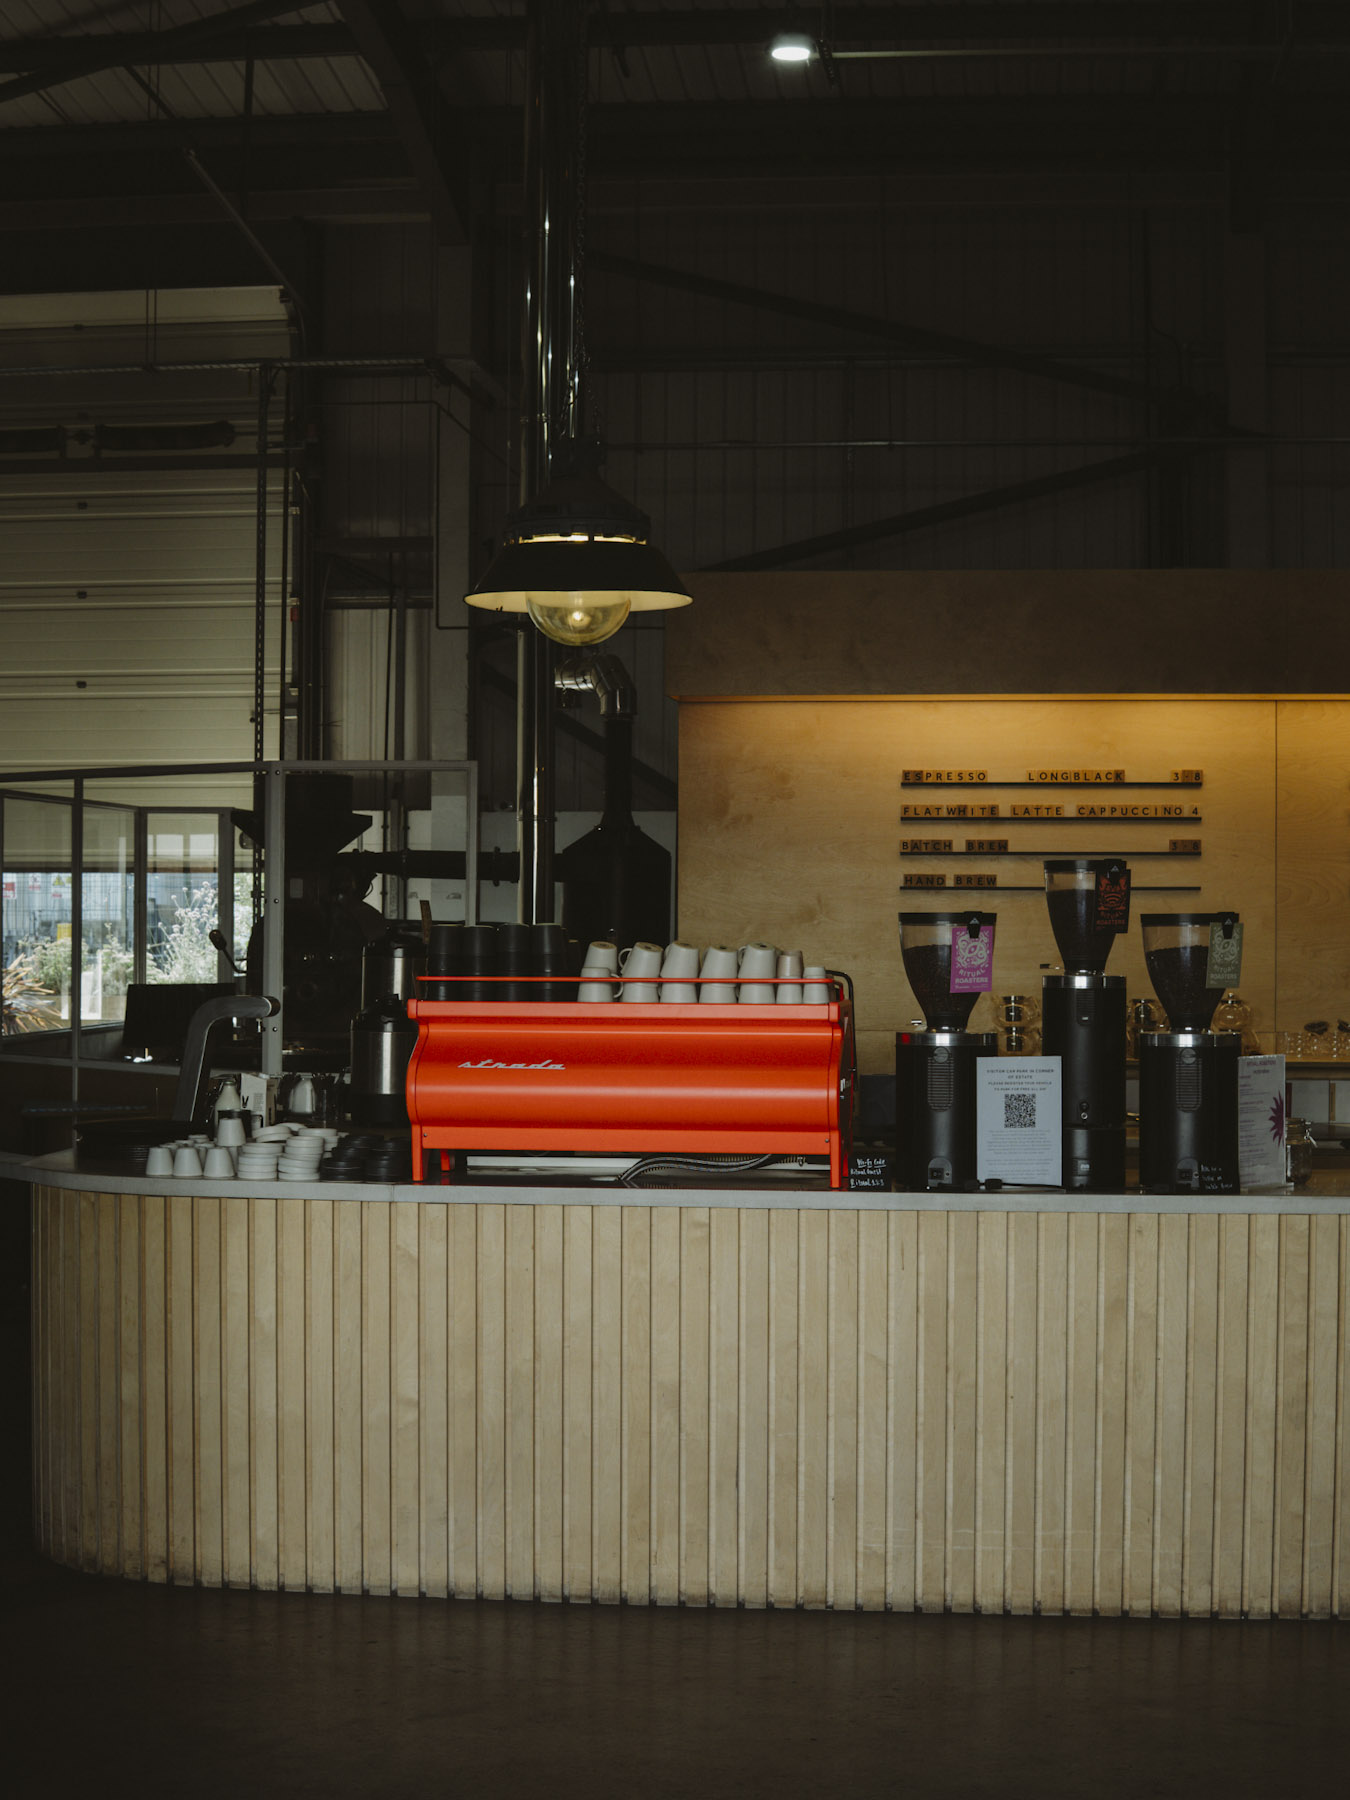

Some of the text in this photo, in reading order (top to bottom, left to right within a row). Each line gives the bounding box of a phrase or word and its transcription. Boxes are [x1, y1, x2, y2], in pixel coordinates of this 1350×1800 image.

[904, 771, 987, 781] ESPRESSO
[1028, 771, 1124, 781] LONGBLACK
[903, 806, 1198, 816] FLATWHITE LATTE CAPPUCCINO 4
[902, 841, 952, 851] BATCH
[967, 841, 1008, 851] BREW
[904, 876, 997, 886] HAND BREW
[958, 967, 986, 978] RITUAL
[457, 1059, 566, 1070] strada
